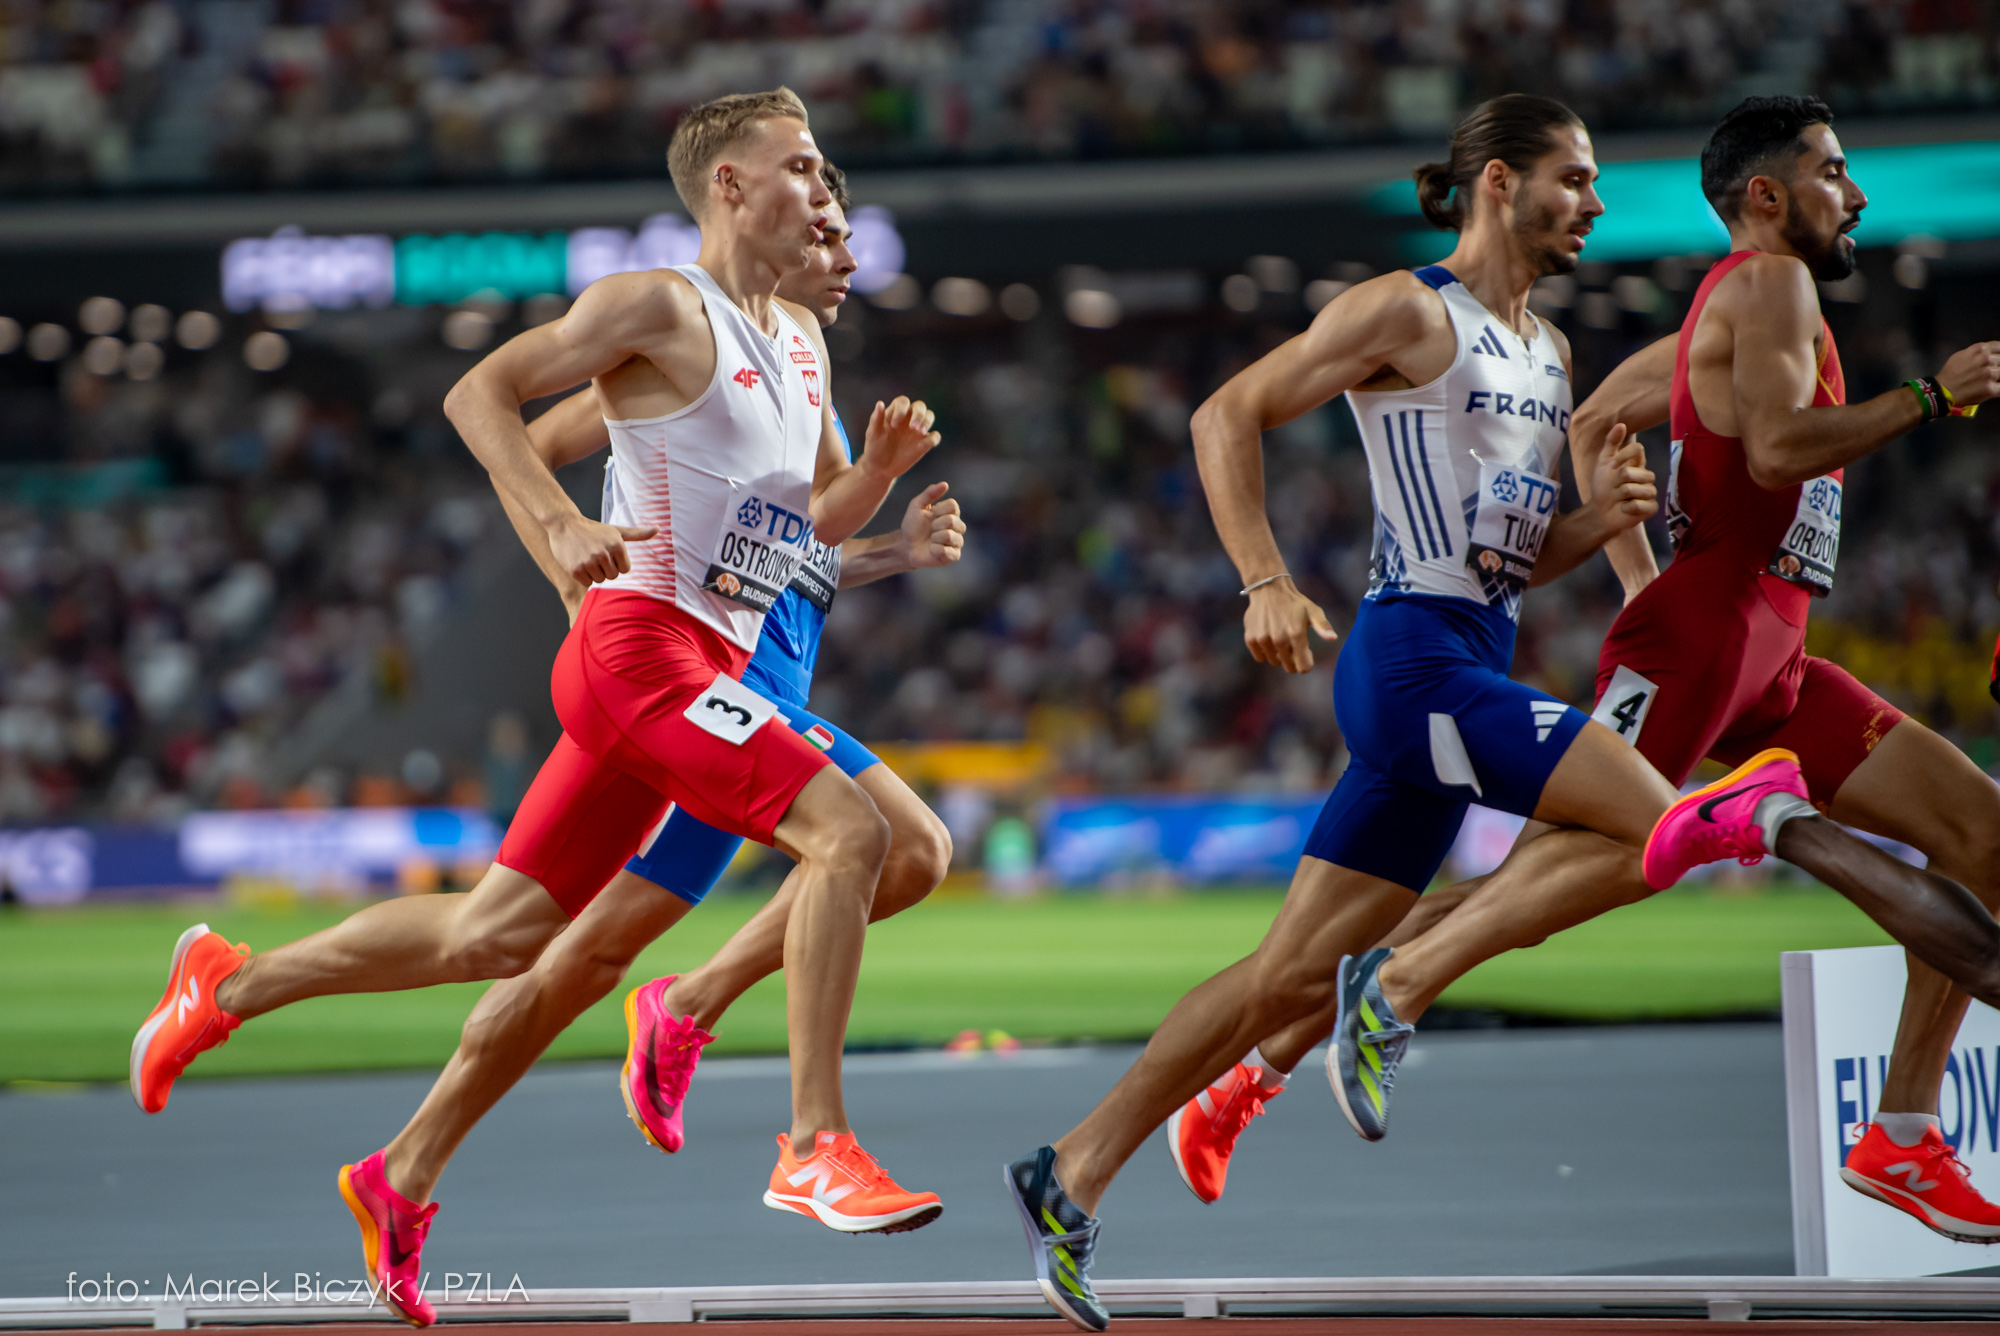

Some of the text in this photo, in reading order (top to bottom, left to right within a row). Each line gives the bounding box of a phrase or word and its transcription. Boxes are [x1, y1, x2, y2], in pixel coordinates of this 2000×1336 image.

[733, 367, 760, 389] 4F
[765, 502, 814, 551] TDK
[706, 695, 752, 726] 3
[1611, 691, 1648, 735] 4
